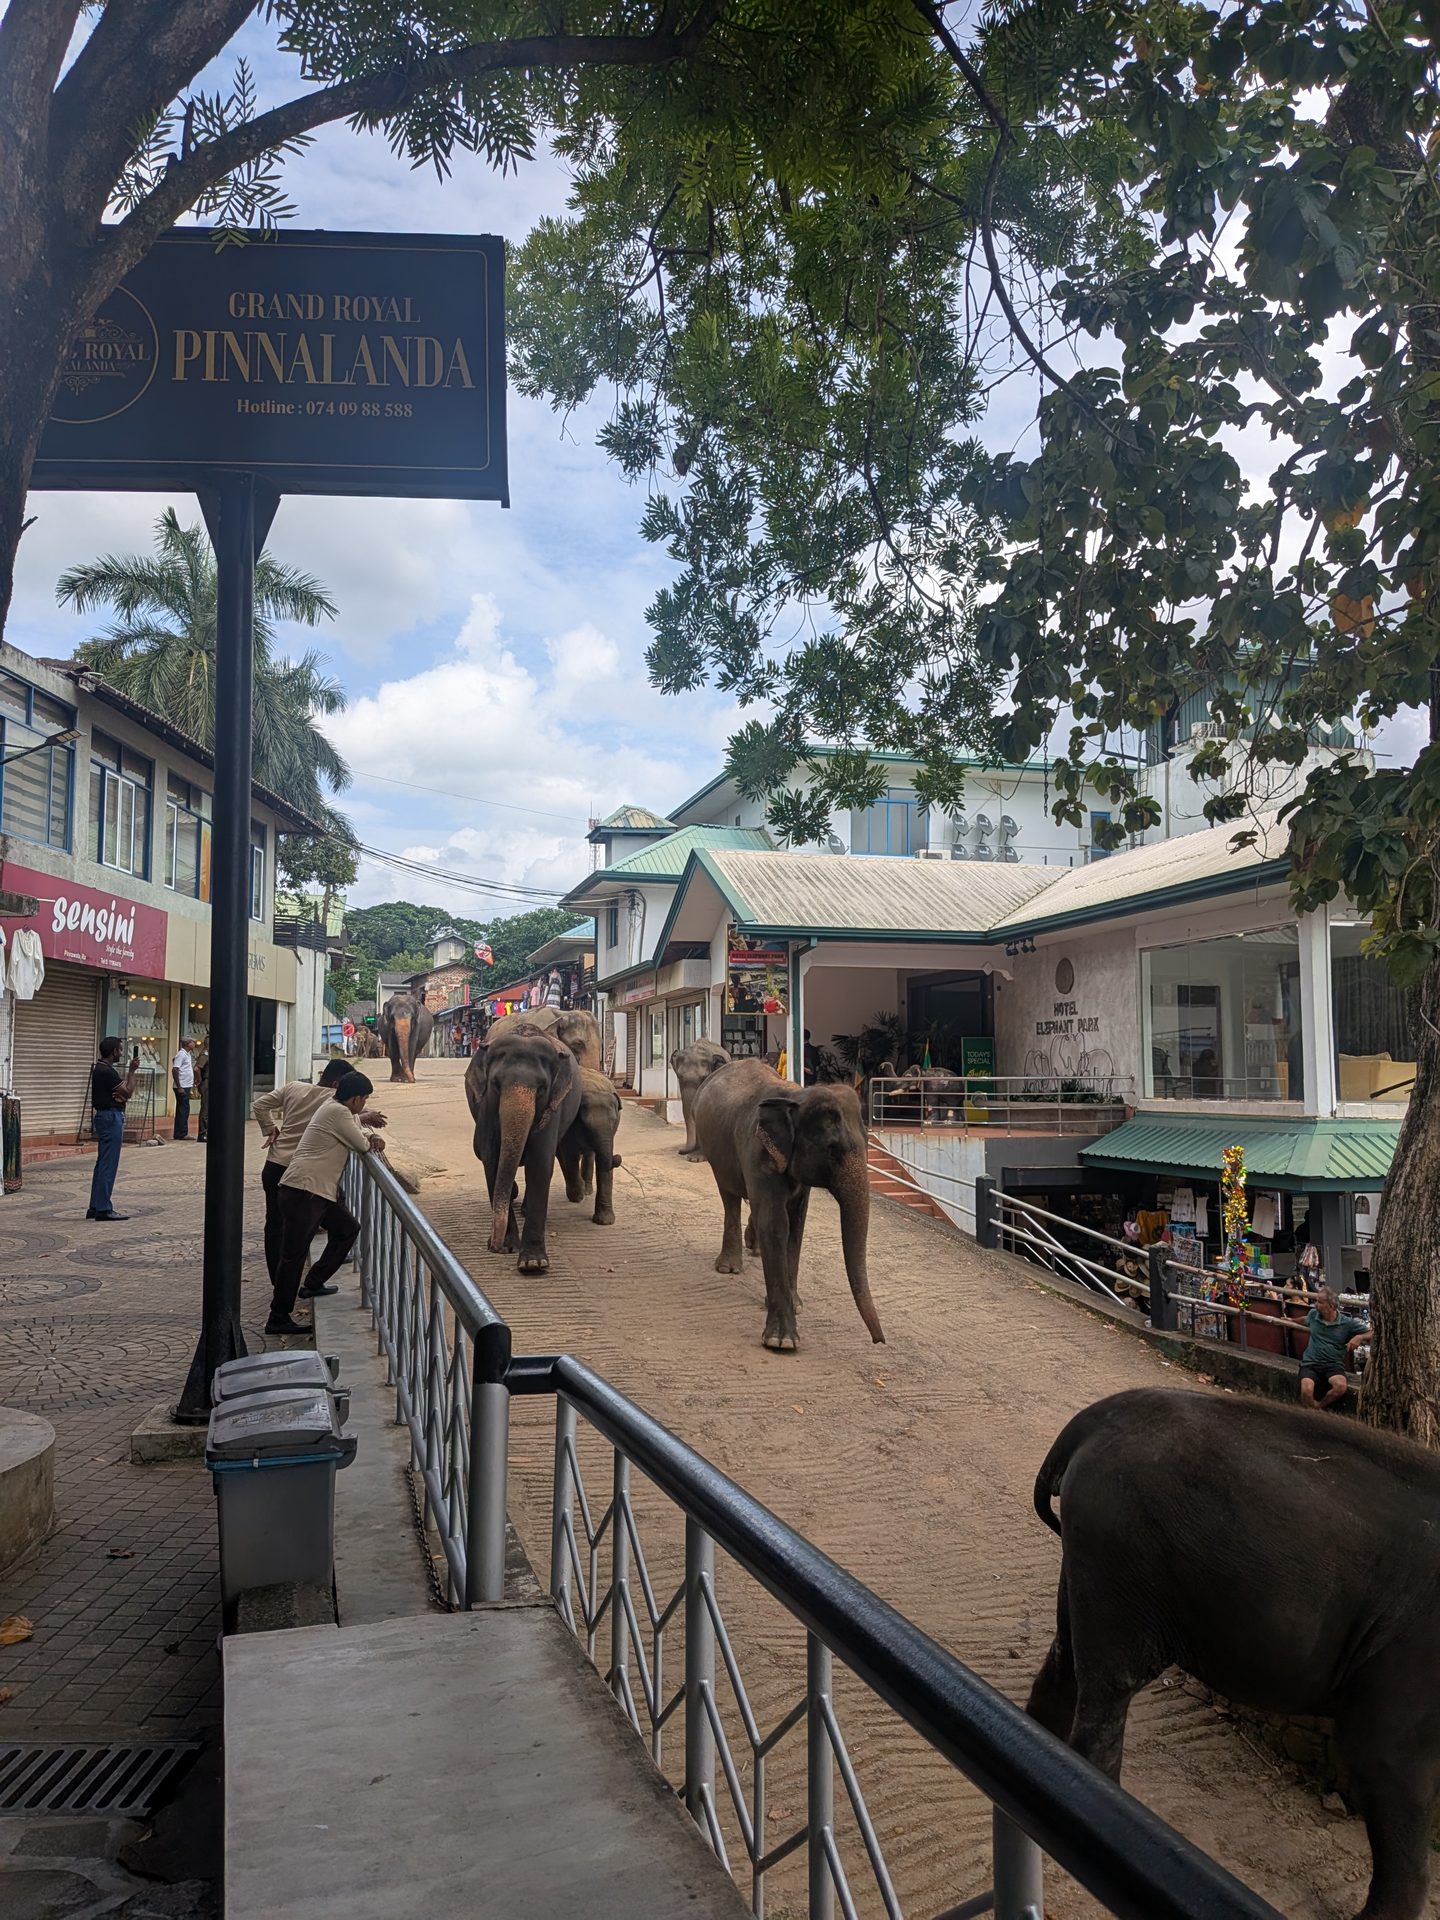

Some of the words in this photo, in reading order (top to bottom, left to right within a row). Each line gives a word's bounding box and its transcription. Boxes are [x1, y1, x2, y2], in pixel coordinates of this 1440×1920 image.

[228, 291, 325, 320] GRAND
[332, 295, 421, 323] ROYAL
[85, 343, 151, 361] ROYAL
[171, 329, 476, 389] PINNALANDA
[236, 399, 295, 415] Hotline
[306, 400, 335, 416] 074
[339, 401, 358, 416] 09
[362, 402, 381, 417] 88
[384, 403, 413, 418] 588
[1053, 1001, 1079, 1017] HOTEL
[1036, 1019, 1074, 1036] ELEPHANT
[1077, 1017, 1100, 1033] PARK
